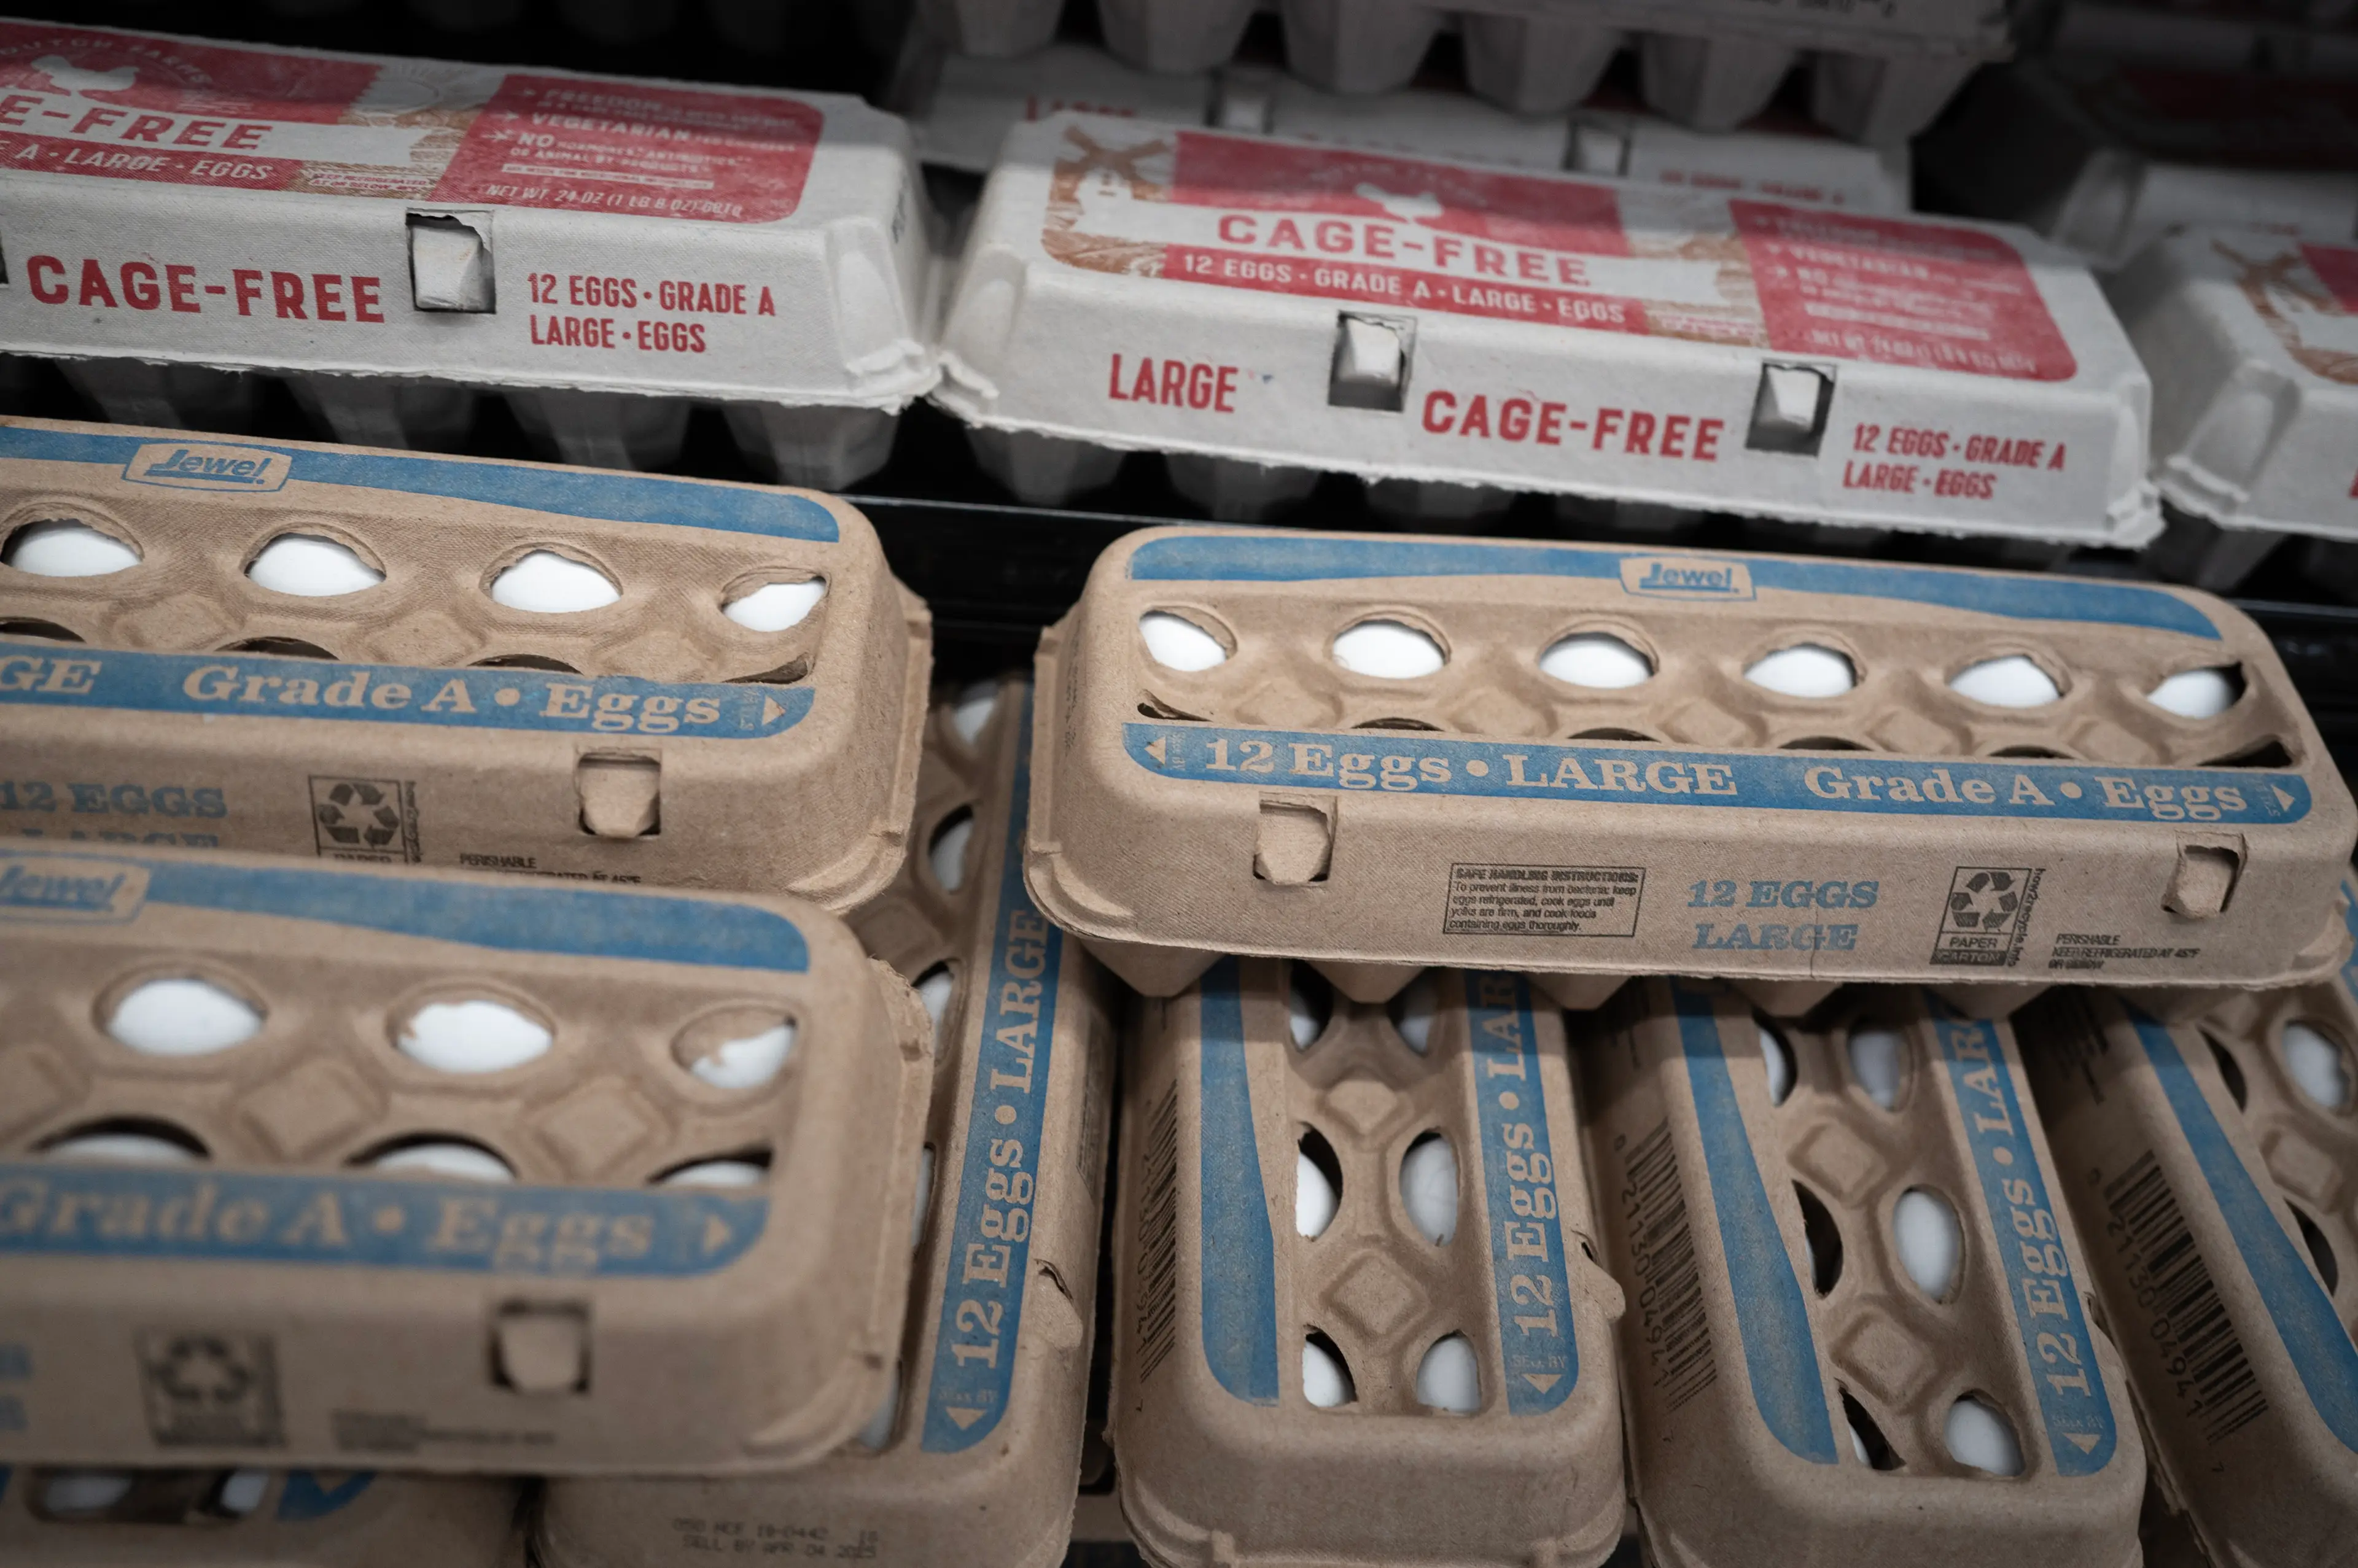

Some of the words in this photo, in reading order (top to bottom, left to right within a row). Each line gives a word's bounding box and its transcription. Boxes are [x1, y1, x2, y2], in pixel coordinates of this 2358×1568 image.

[518, 132, 554, 148] NO
[532, 112, 691, 142] VEGETARIAN
[15, 144, 40, 160] A
[63, 149, 171, 172] LARGE
[191, 160, 274, 180] EGGS
[485, 184, 519, 197] NET
[554, 188, 577, 202] 24
[628, 195, 652, 208] LB
[1217, 214, 1590, 287] CAGE-FREE
[26, 255, 385, 324] CAGE-FREE
[527, 273, 557, 305] 12
[568, 275, 638, 308] EGGS
[659, 280, 747, 316] GRADE
[758, 286, 777, 317] A
[1184, 254, 1213, 275] 12
[1223, 257, 1291, 284] EGGS
[1314, 268, 1402, 296] GRADE
[1413, 279, 1432, 299] A
[1451, 285, 1536, 314] LARGE
[1557, 297, 1627, 324] EGGS
[529, 314, 616, 350] LARGE
[637, 320, 707, 354] EGGS
[1108, 354, 1239, 413] LARGE
[1421, 390, 1724, 462] CAGE-FREE
[1853, 422, 1881, 454] 12
[1887, 425, 1950, 460] EGGS
[1964, 434, 2045, 472] GRADE
[2047, 443, 2067, 472] A
[144, 449, 271, 483] Jewel
[1843, 460, 1920, 494] LARGE
[1934, 468, 1999, 500] EGGS
[1639, 562, 1733, 592] Jewel
[183, 665, 412, 710] Grade
[421, 678, 478, 713] A
[539, 683, 721, 734] Eggs
[0, 781, 56, 812] 12
[68, 782, 228, 818] EGGS
[1205, 738, 1275, 773] 12
[1290, 742, 1453, 791] Eggs
[1503, 753, 1737, 796] LARGE
[1804, 765, 1997, 805] Grade
[2009, 774, 2056, 806] A
[2094, 774, 2247, 821] Eggs
[1455, 881, 1466, 891] To
[1469, 883, 1506, 894] prevent
[1509, 883, 1539, 893] illness
[1542, 884, 1565, 894] from
[1613, 886, 1637, 896] keep
[1456, 867, 1487, 879] SAFE
[1490, 869, 1548, 880] HANDLING
[1687, 880, 1735, 908] 12
[1745, 880, 1880, 909] EGGS
[1449, 906, 1477, 918] yolks
[1479, 908, 1495, 917] are
[1498, 907, 1520, 918] firm,
[1523, 908, 1542, 918] and
[1544, 909, 1568, 918] cook
[1570, 909, 1597, 919] foods
[1453, 895, 1477, 906] eggs
[1541, 896, 1565, 906] cook
[1567, 898, 1591, 907] eggs
[1593, 896, 1616, 907] until
[2007, 867, 2046, 967] how2recycle.info
[1449, 920, 1500, 931] containing
[1502, 921, 1526, 931] eggs
[1528, 920, 1582, 933] thoroughly.
[1691, 923, 1859, 951] LARGE
[1949, 936, 1998, 949] PAPER
[2055, 933, 2120, 945] PERISHABLE
[1940, 952, 2001, 964] CARTON
[2080, 947, 2158, 959] REFRIGERATED
[2157, 947, 2174, 958] AT
[990, 909, 1047, 1094] LARGE
[1481, 975, 1527, 1082] LAR
[1950, 1019, 2015, 1136] LAR
[962, 1138, 1034, 1289] Eggs
[1502, 1122, 1558, 1263] Eggs
[1622, 1179, 1652, 1278] 21130
[2002, 1178, 2069, 1321] Eggs
[1509, 1274, 1560, 1339] 12
[2107, 1214, 2153, 1311] 21130
[2149, 1315, 2209, 1419] 04941
[952, 1298, 1004, 1369] 12
[2036, 1332, 2092, 1397] 12
